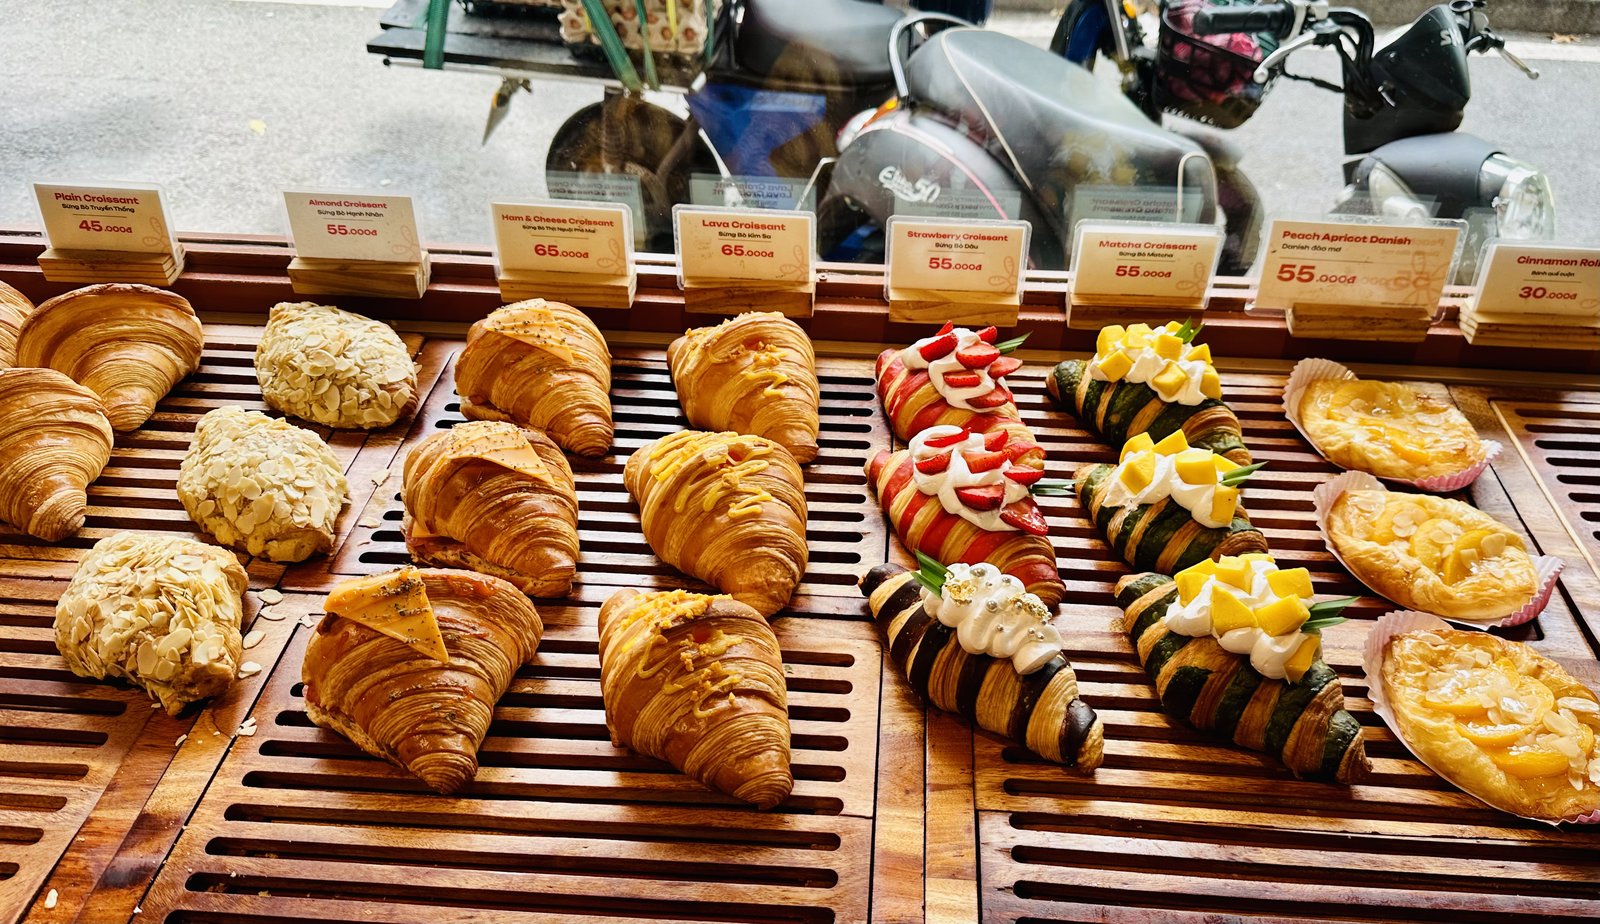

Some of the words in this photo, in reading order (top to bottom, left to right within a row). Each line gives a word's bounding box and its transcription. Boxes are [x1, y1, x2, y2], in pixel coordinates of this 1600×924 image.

[54, 192, 82, 201] Plain
[84, 194, 140, 205] Croissant
[309, 199, 342, 207] Almond
[344, 201, 388, 209] Croissant
[501, 214, 524, 222] Ham
[533, 215, 567, 224] Cheese
[569, 218, 614, 227] Croissant
[702, 219, 729, 228] Lava
[731, 221, 786, 231] Croissant
[907, 230, 961, 241] Strawberry
[962, 233, 1008, 242] Croissant
[1282, 230, 1322, 241] Peach
[1321, 233, 1367, 244] Apricot
[1369, 235, 1412, 246] Danish
[1099, 240, 1142, 249] Matcha
[1143, 242, 1198, 251] Croissant
[1281, 243, 1310, 251] Danish
[1517, 255, 1577, 266] Cinnamon
